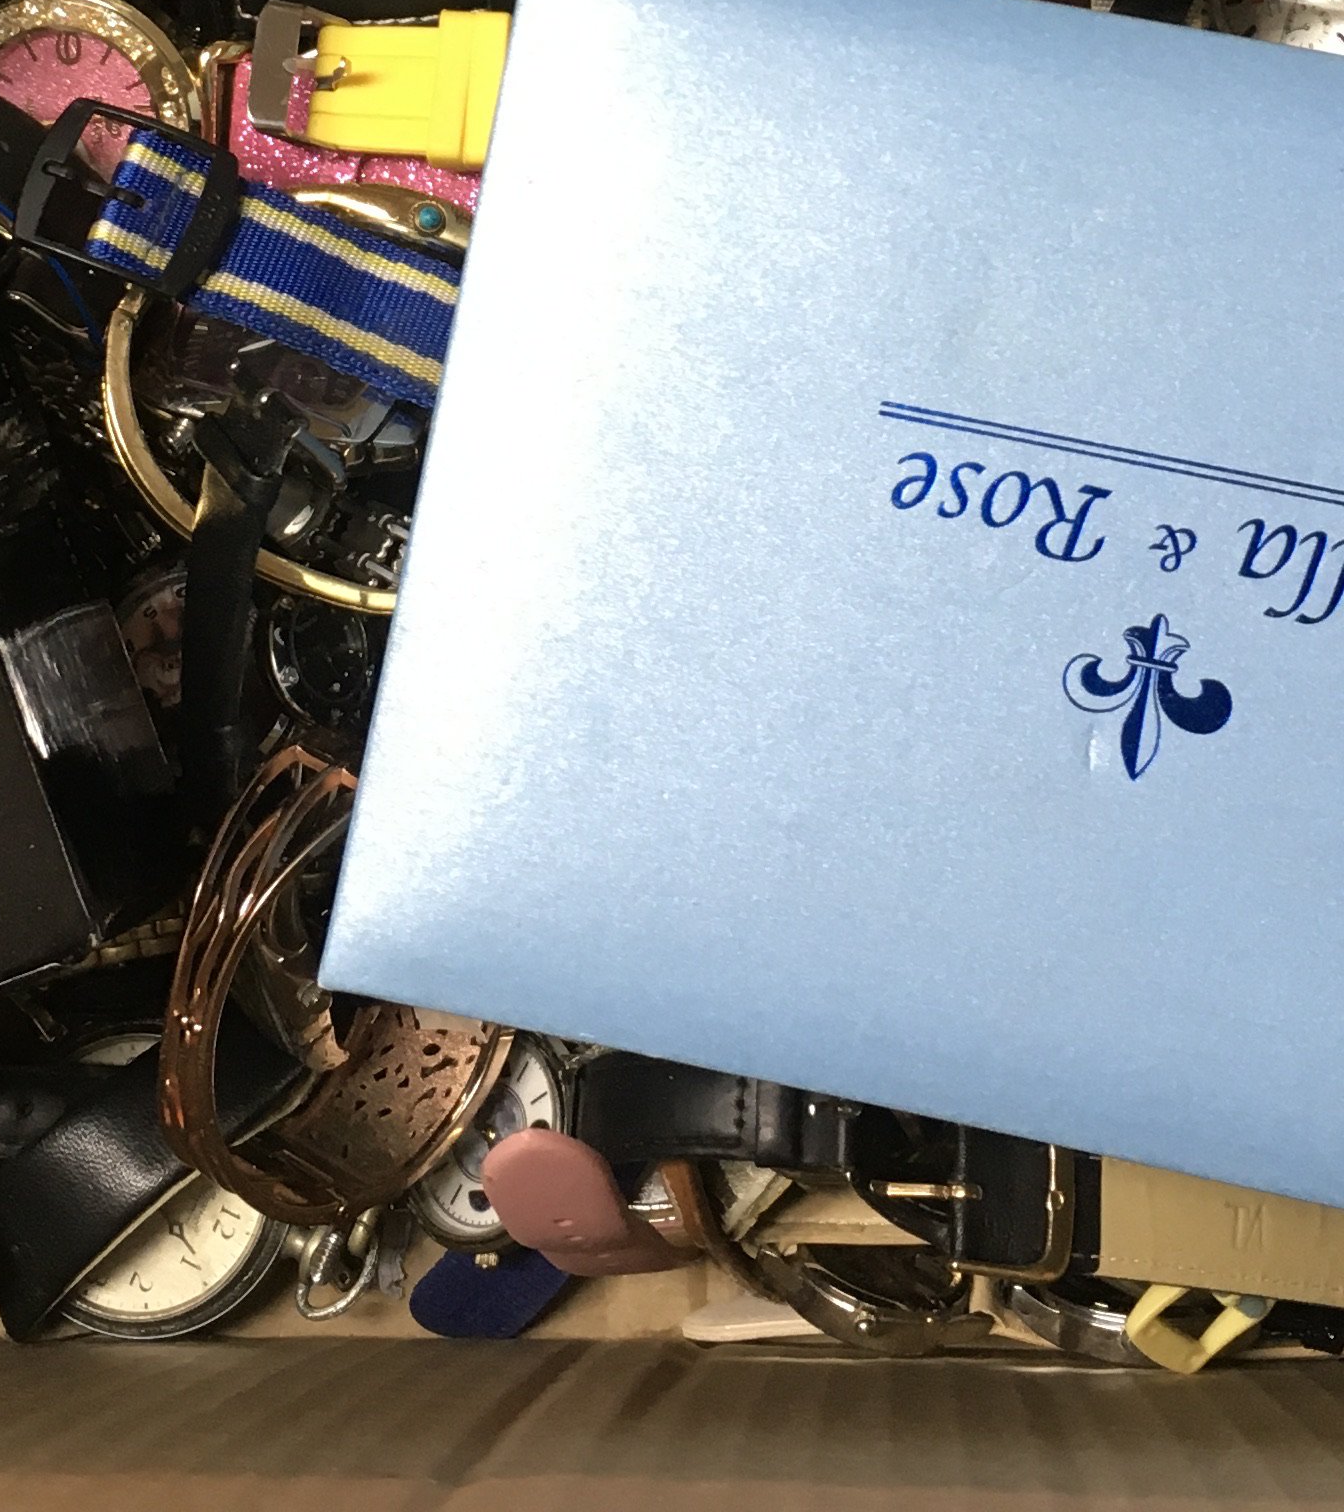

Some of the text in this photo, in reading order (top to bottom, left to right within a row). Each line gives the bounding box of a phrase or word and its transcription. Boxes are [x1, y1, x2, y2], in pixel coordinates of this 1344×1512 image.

[889, 450, 1114, 563] Rose
[1147, 523, 1198, 573] &
[212, 1205, 242, 1240] 12
[180, 1255, 203, 1272] 1
[129, 1271, 155, 1293] 2
